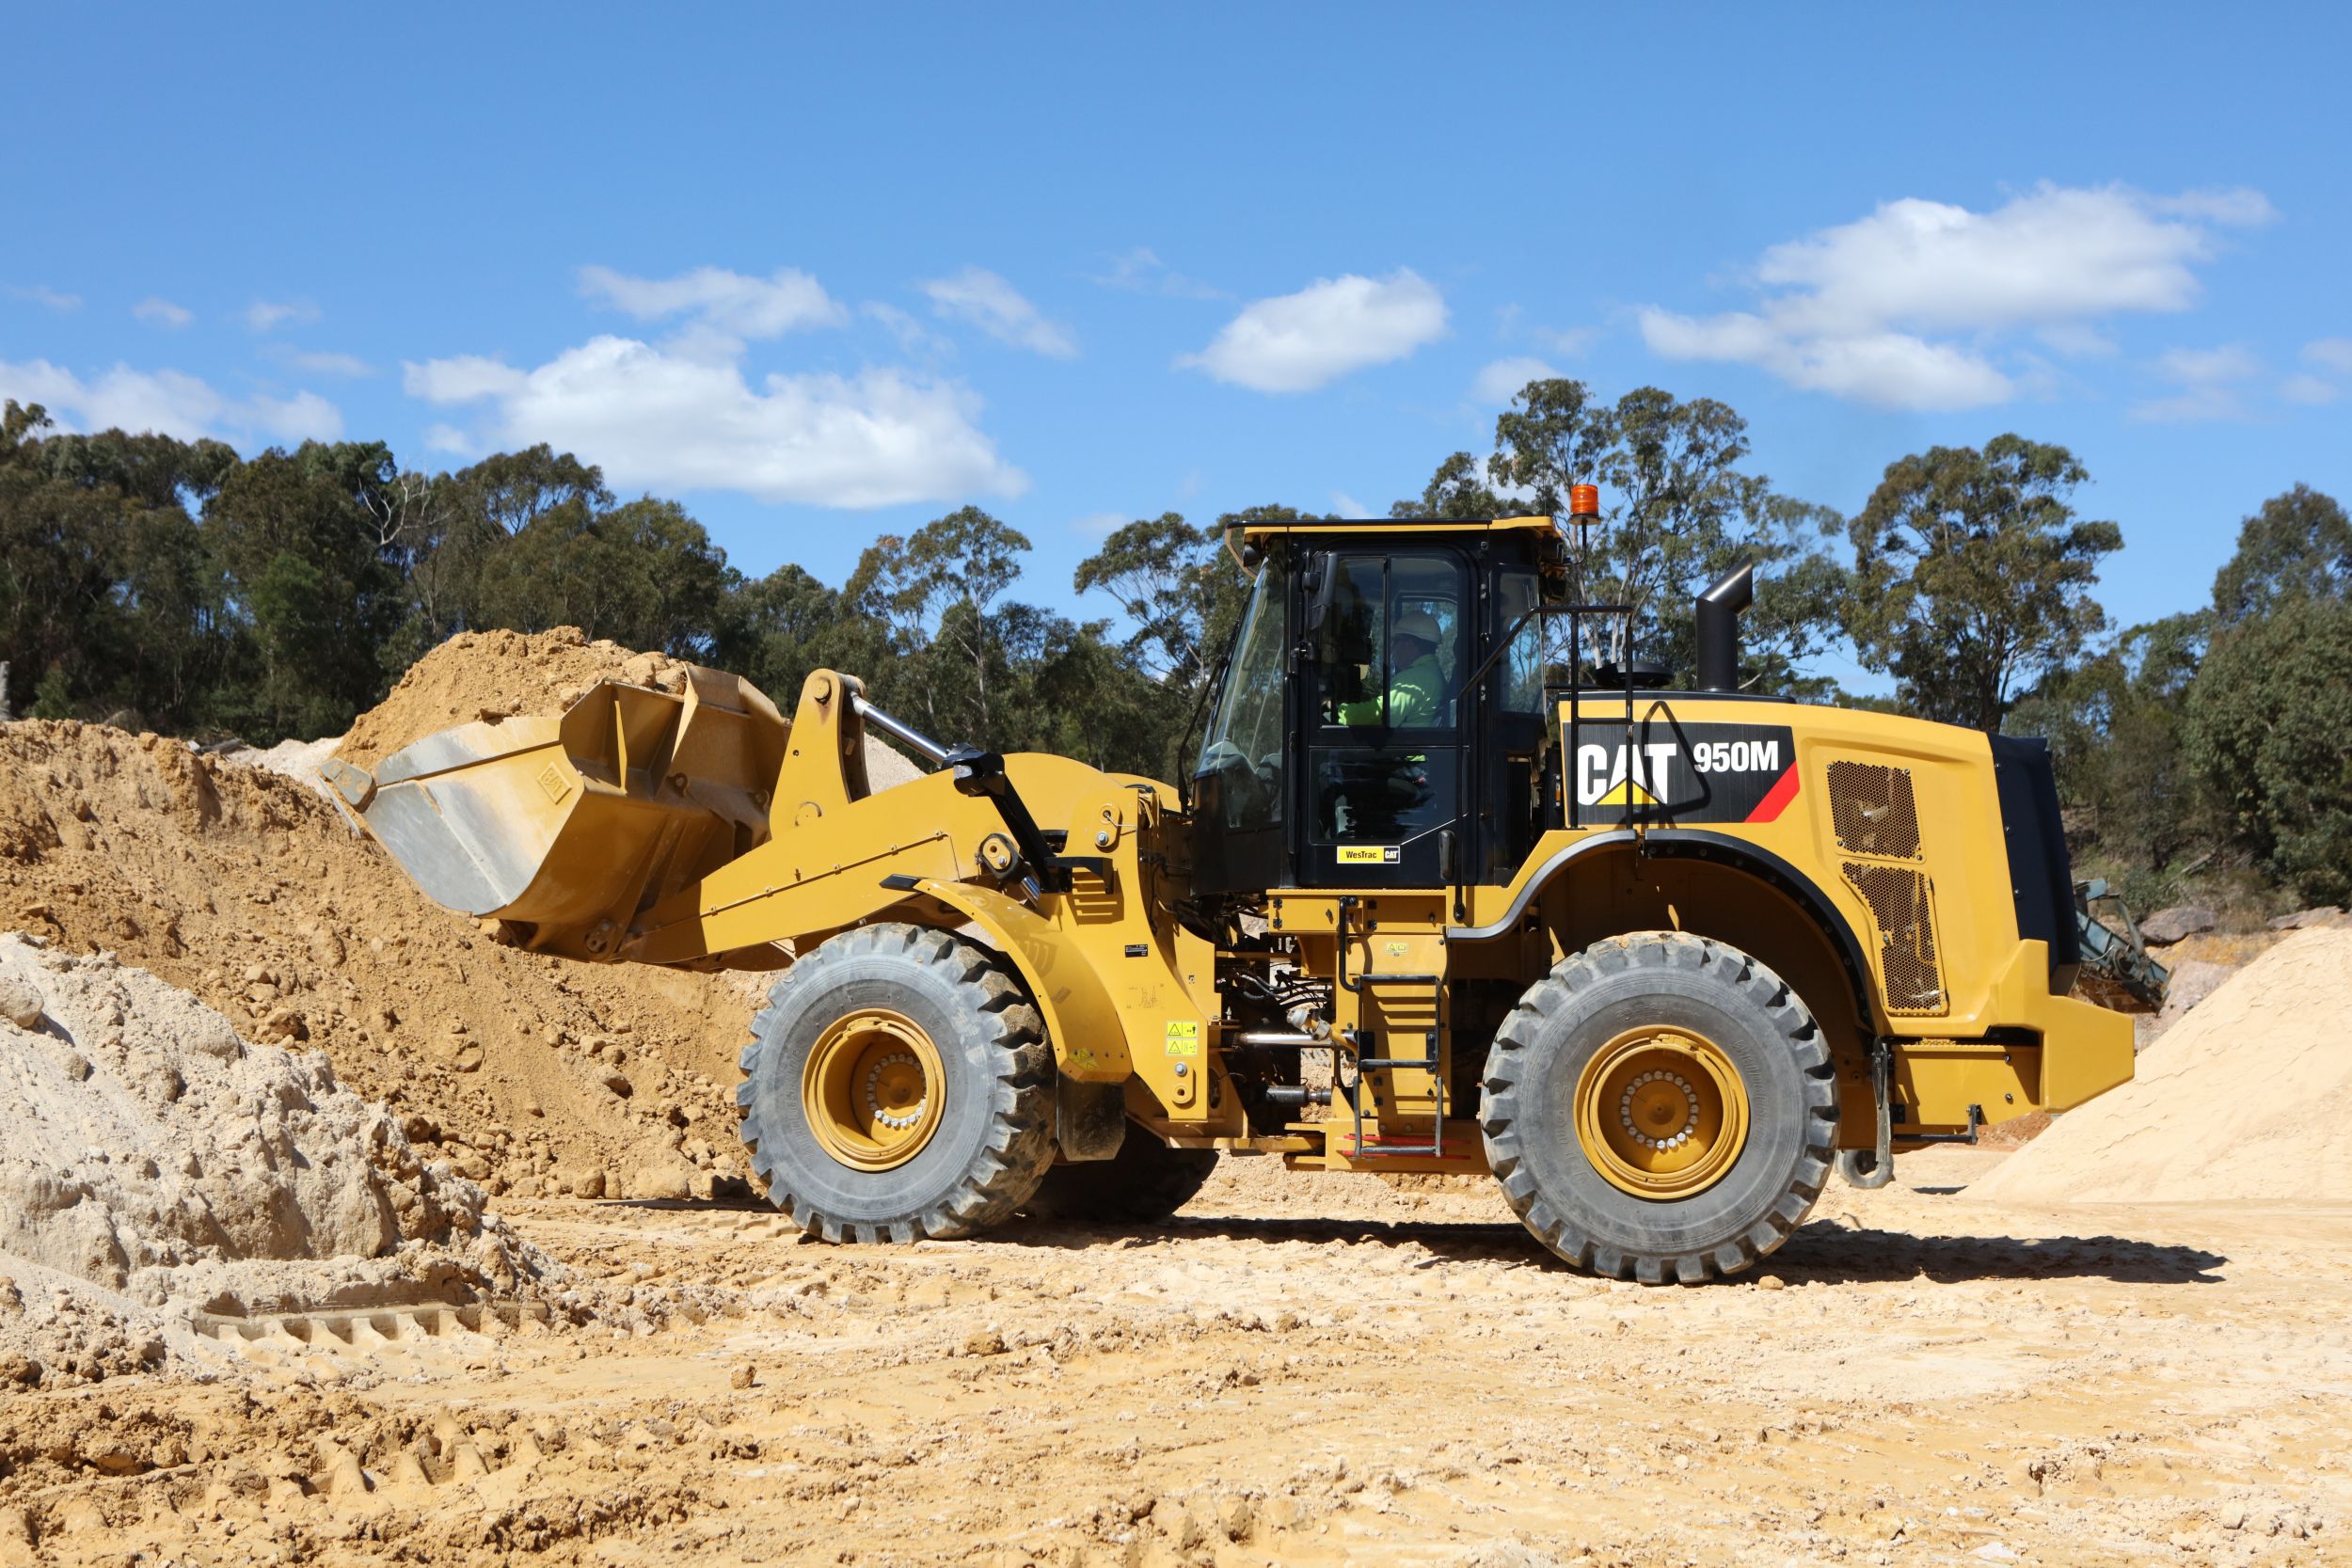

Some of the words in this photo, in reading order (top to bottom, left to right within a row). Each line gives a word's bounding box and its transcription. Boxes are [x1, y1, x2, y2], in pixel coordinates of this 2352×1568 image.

[1578, 744, 1677, 806] CAT
[1693, 740, 1779, 772] 950M
[1345, 850, 1377, 859] WesTrac
[1384, 850, 1399, 859] CAT
